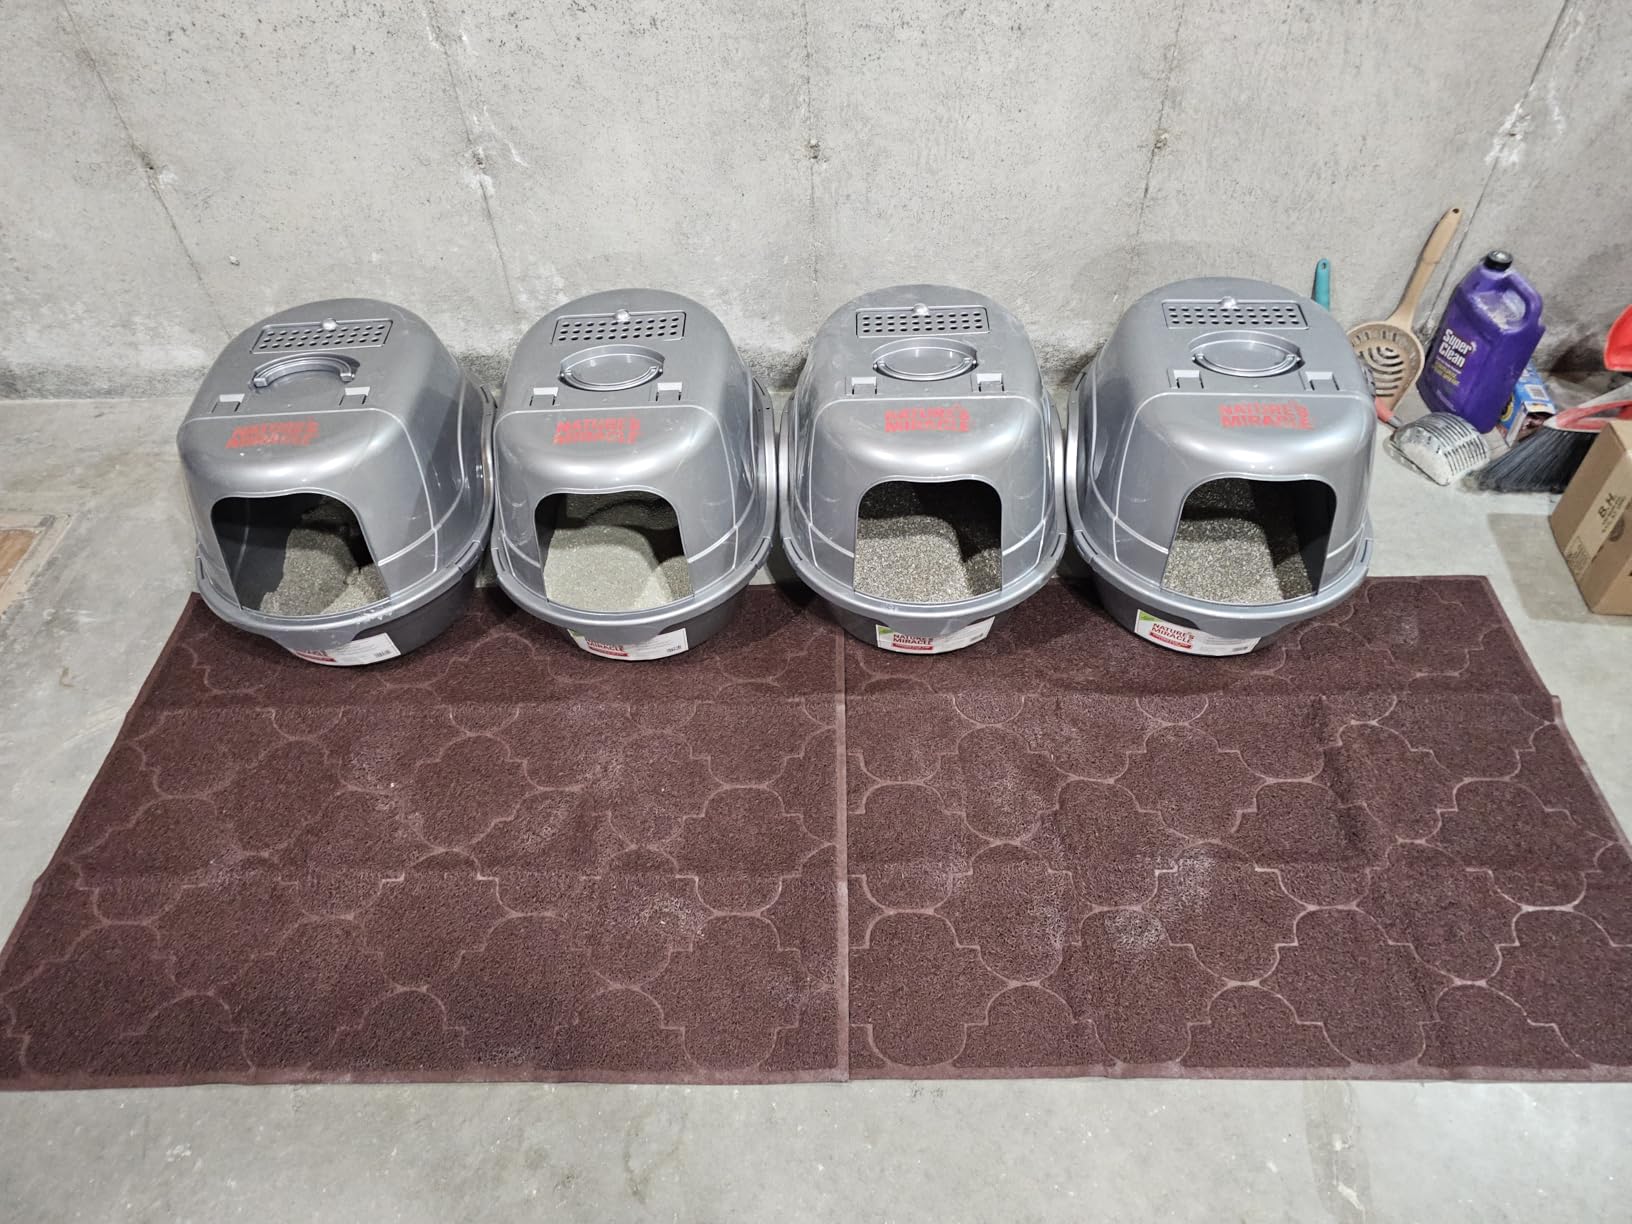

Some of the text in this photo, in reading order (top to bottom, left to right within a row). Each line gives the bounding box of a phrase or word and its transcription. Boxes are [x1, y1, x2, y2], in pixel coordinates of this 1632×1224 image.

[1442, 328, 1472, 355] Super
[1438, 341, 1466, 368] Clean
[1151, 627, 1192, 643] MIRACLE
[1153, 622, 1195, 641] NATURE'S
